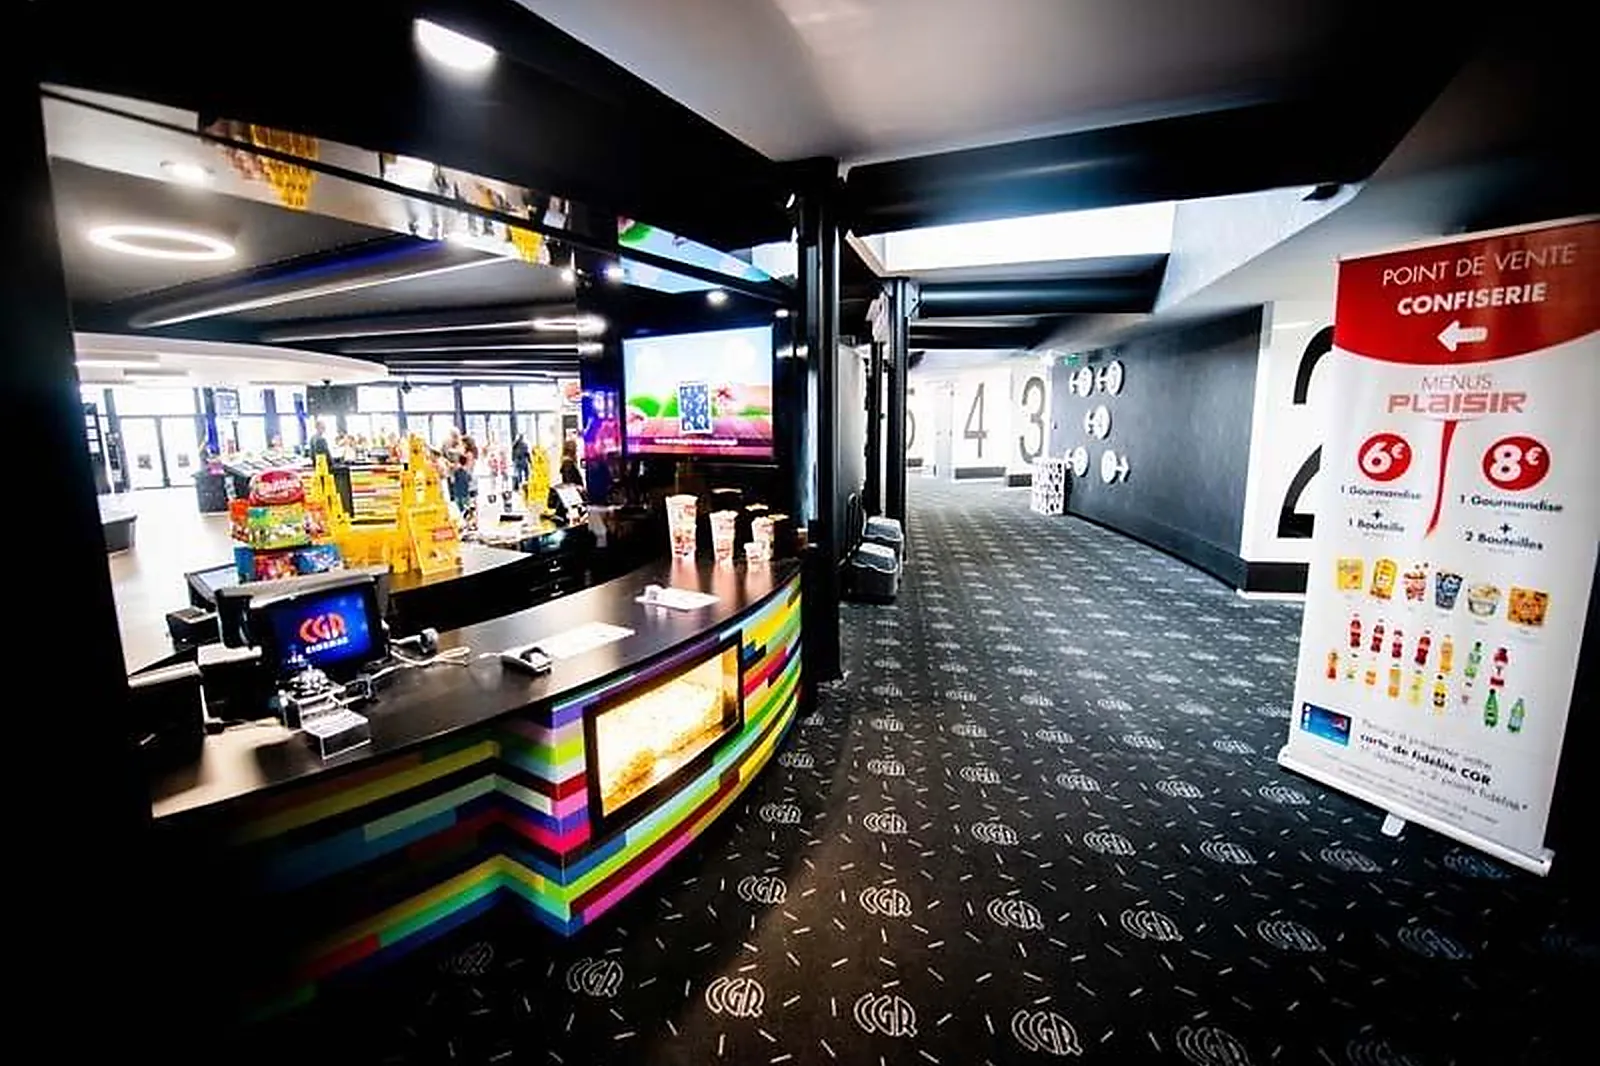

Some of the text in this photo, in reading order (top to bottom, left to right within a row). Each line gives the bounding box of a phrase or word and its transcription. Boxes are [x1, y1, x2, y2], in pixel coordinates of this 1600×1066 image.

[1383, 244, 1577, 286] POINT DE VENTE
[1397, 282, 1549, 316] CONFISERIE
[1421, 373, 1492, 391] MENUS
[964, 383, 987, 458] 4
[1020, 376, 1045, 464] 3
[1361, 441, 1404, 474] 6€
[1490, 444, 1543, 482] 8€
[1471, 493, 1563, 513] Gourmandise
[1464, 530, 1474, 543] 2
[1478, 532, 1544, 552] Bouteilles
[299, 612, 347, 643] CGR
[1461, 768, 1492, 786] CGR
[759, 803, 801, 824] CGR
[863, 813, 907, 834] CGR
[972, 822, 1019, 845] CGR
[737, 876, 787, 903] CGR
[859, 887, 912, 917] CGR
[988, 900, 1044, 931] CGR
[1119, 908, 1183, 943] CGR
[567, 958, 624, 998] CGR
[706, 977, 765, 1018] CGR
[854, 993, 917, 1038] CGR
[1010, 1008, 1083, 1056] CGR
